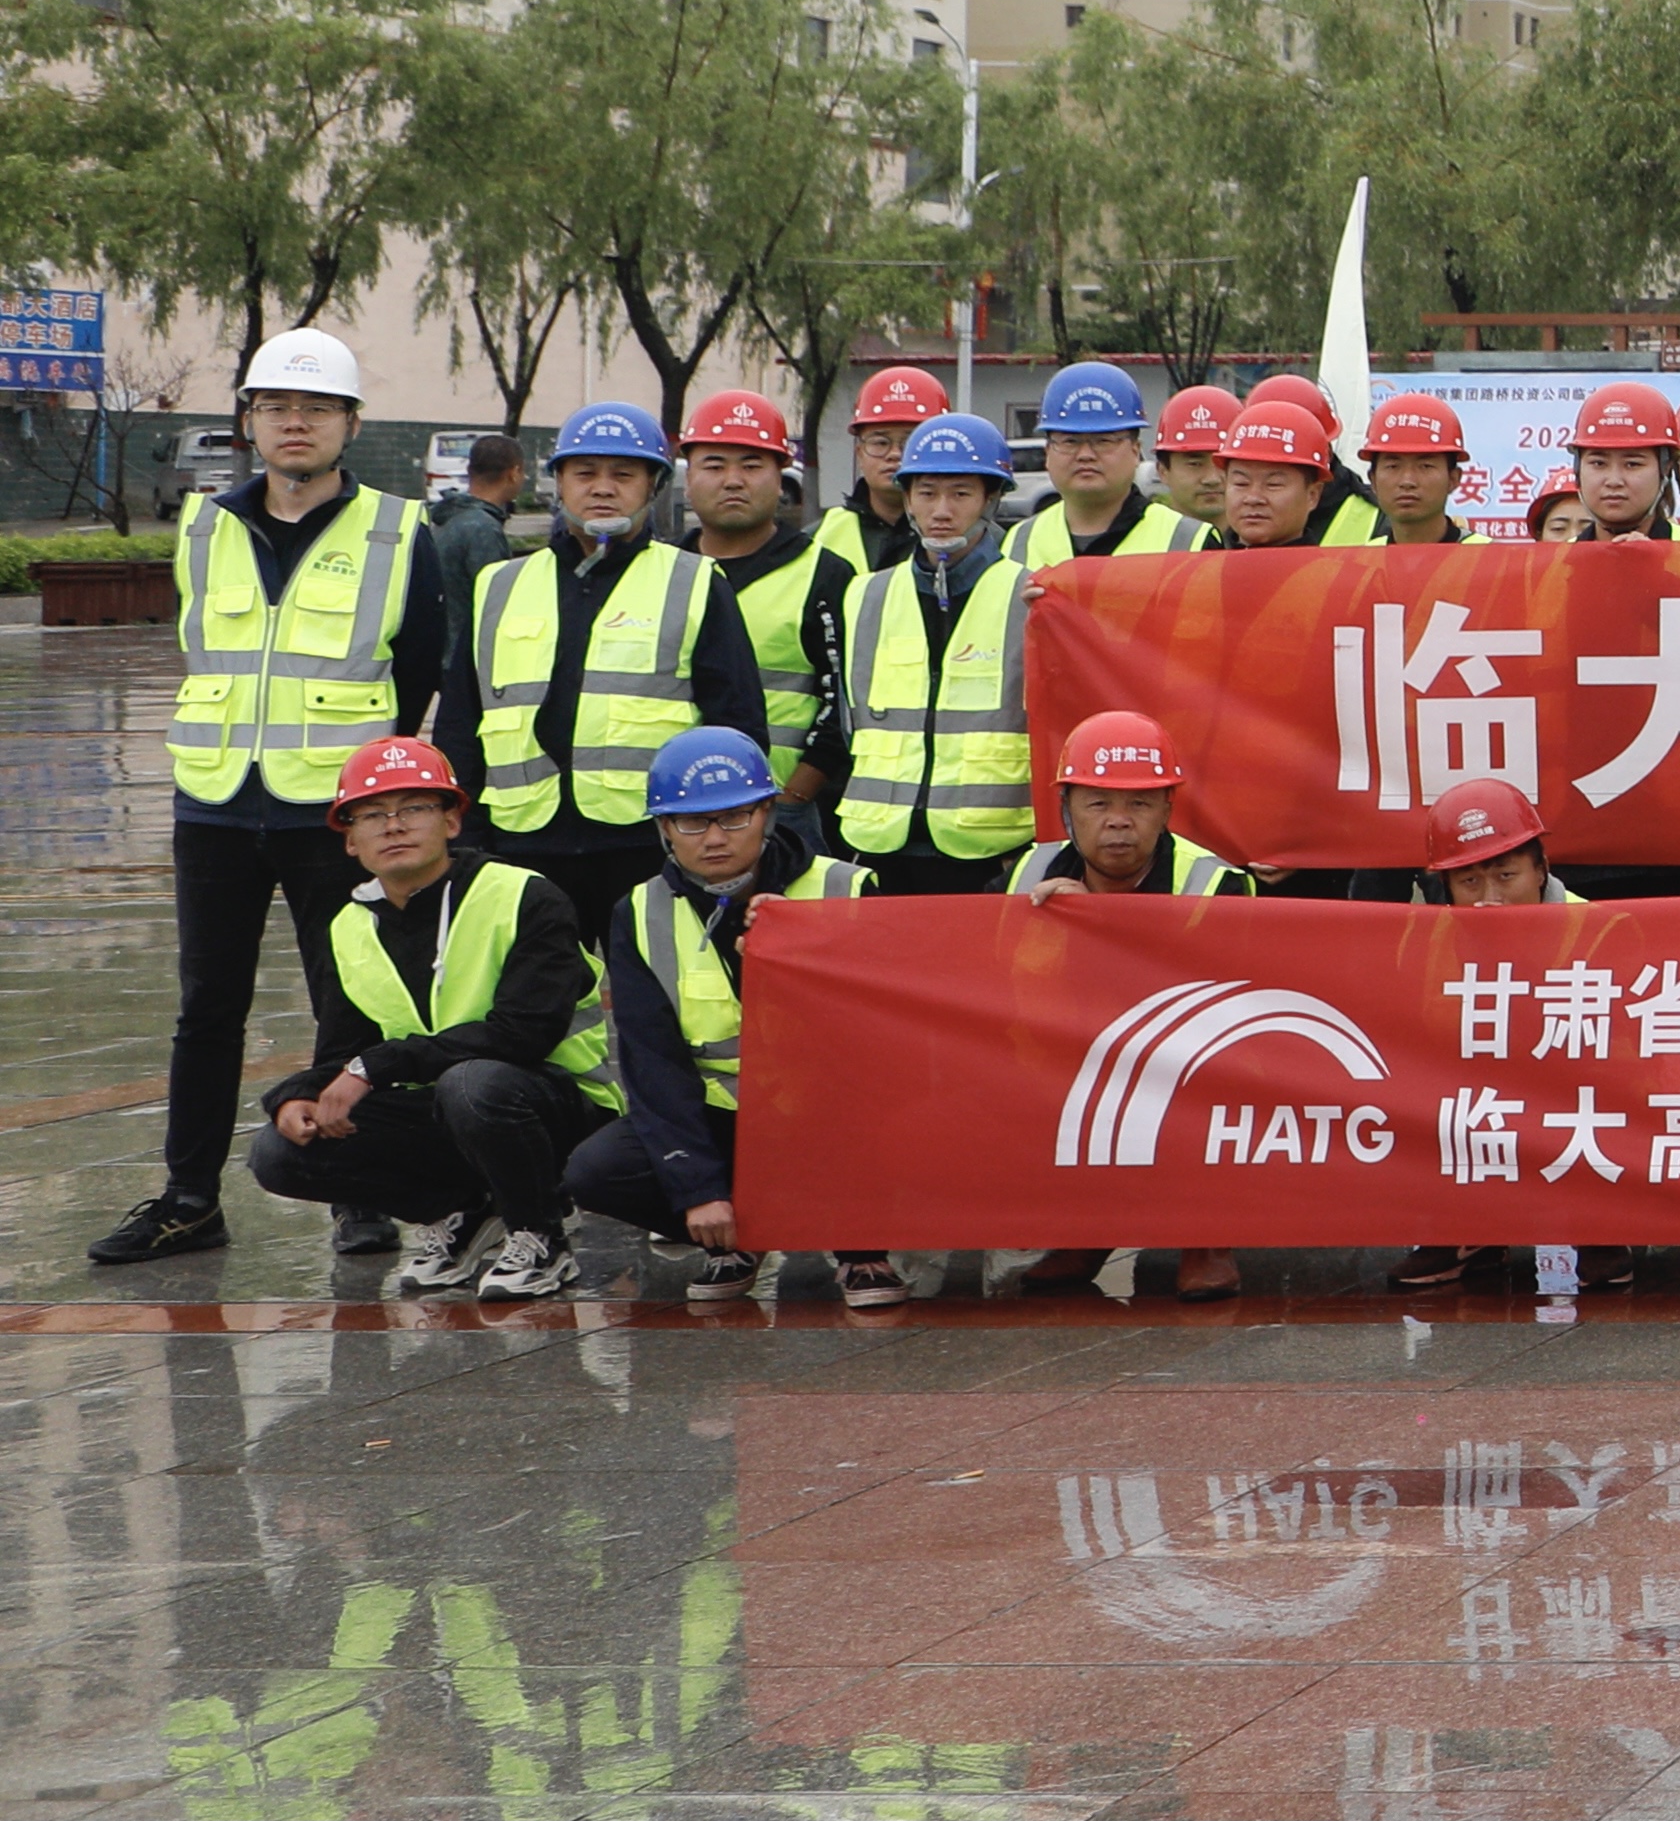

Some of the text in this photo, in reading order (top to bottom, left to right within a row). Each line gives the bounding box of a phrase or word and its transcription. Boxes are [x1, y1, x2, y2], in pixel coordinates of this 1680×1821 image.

[0, 320, 74, 350] 停车场
[1078, 400, 1103, 412] 监理
[595, 425, 622, 438] 监理
[1398, 414, 1442, 432] 甘肃二建
[1246, 423, 1296, 444] 甘肃二建
[1518, 426, 1576, 448] 202
[930, 440, 956, 452] 监理
[1110, 746, 1162, 765] 甘肃二建
[701, 769, 730, 786] 监理
[1206, 1106, 1394, 1166] HATG
